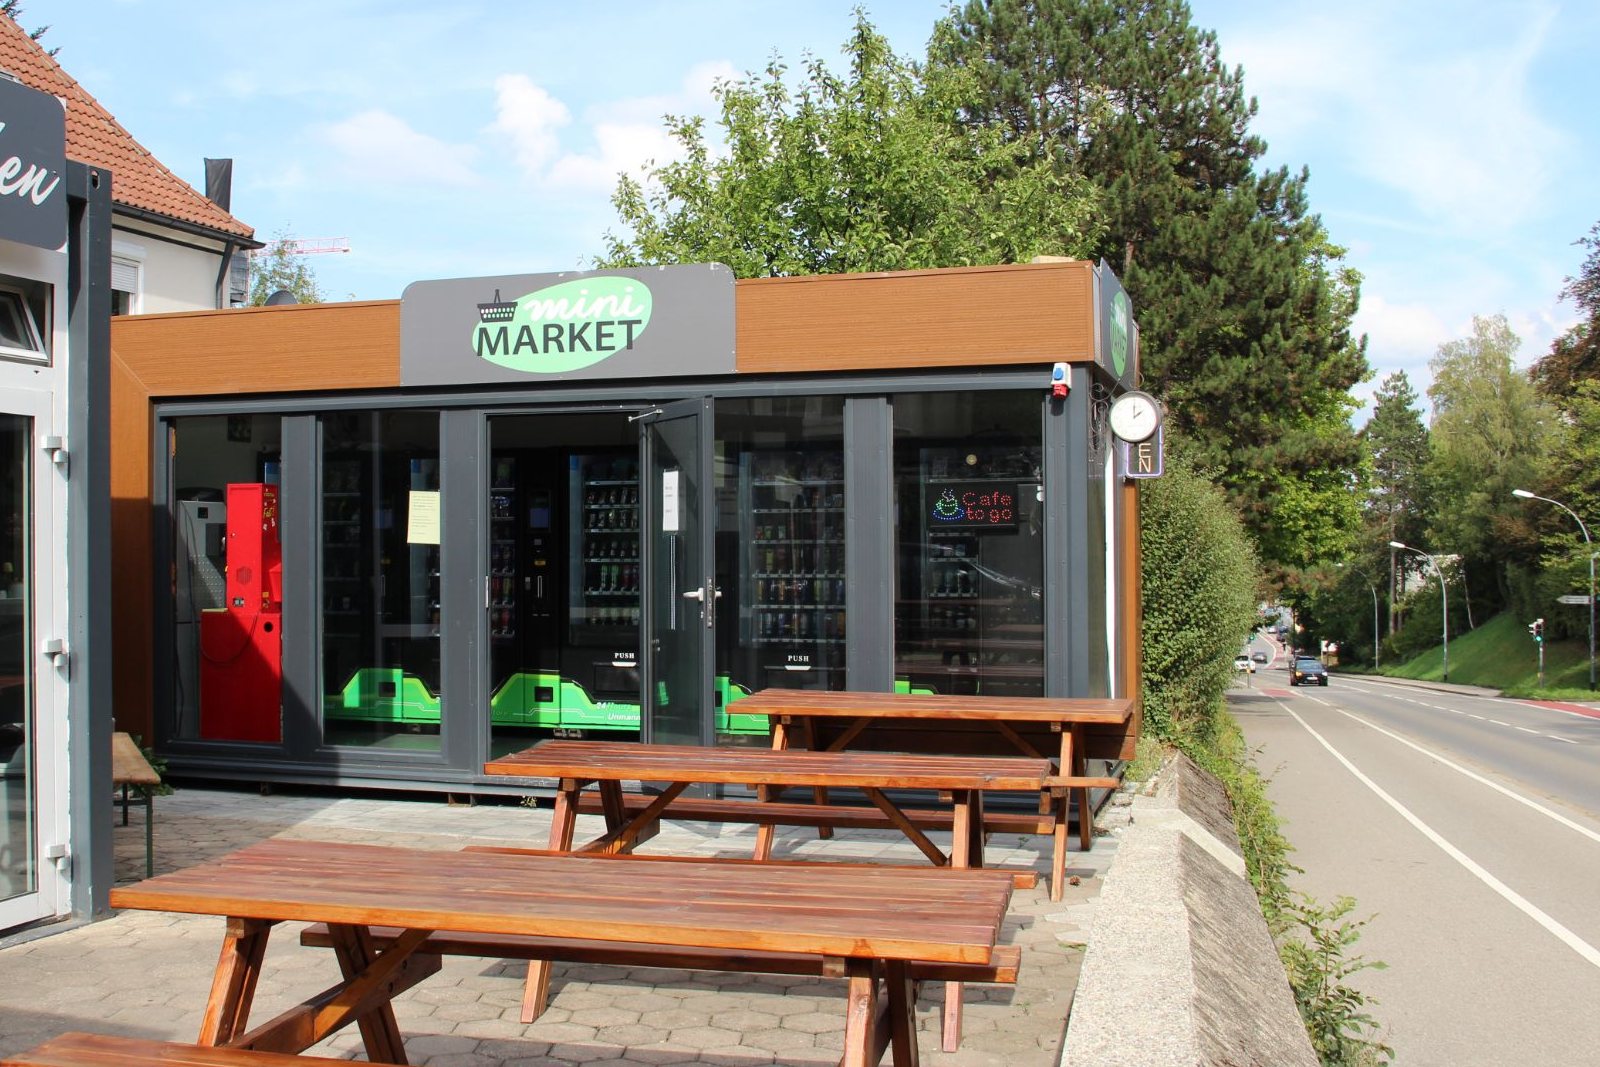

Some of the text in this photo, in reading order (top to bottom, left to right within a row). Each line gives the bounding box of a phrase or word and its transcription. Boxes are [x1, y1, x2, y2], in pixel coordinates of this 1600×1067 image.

[522, 286, 645, 321] mini
[477, 319, 643, 356] MARKET
[962, 491, 1012, 506] Cafe
[966, 506, 1012, 523] to go
